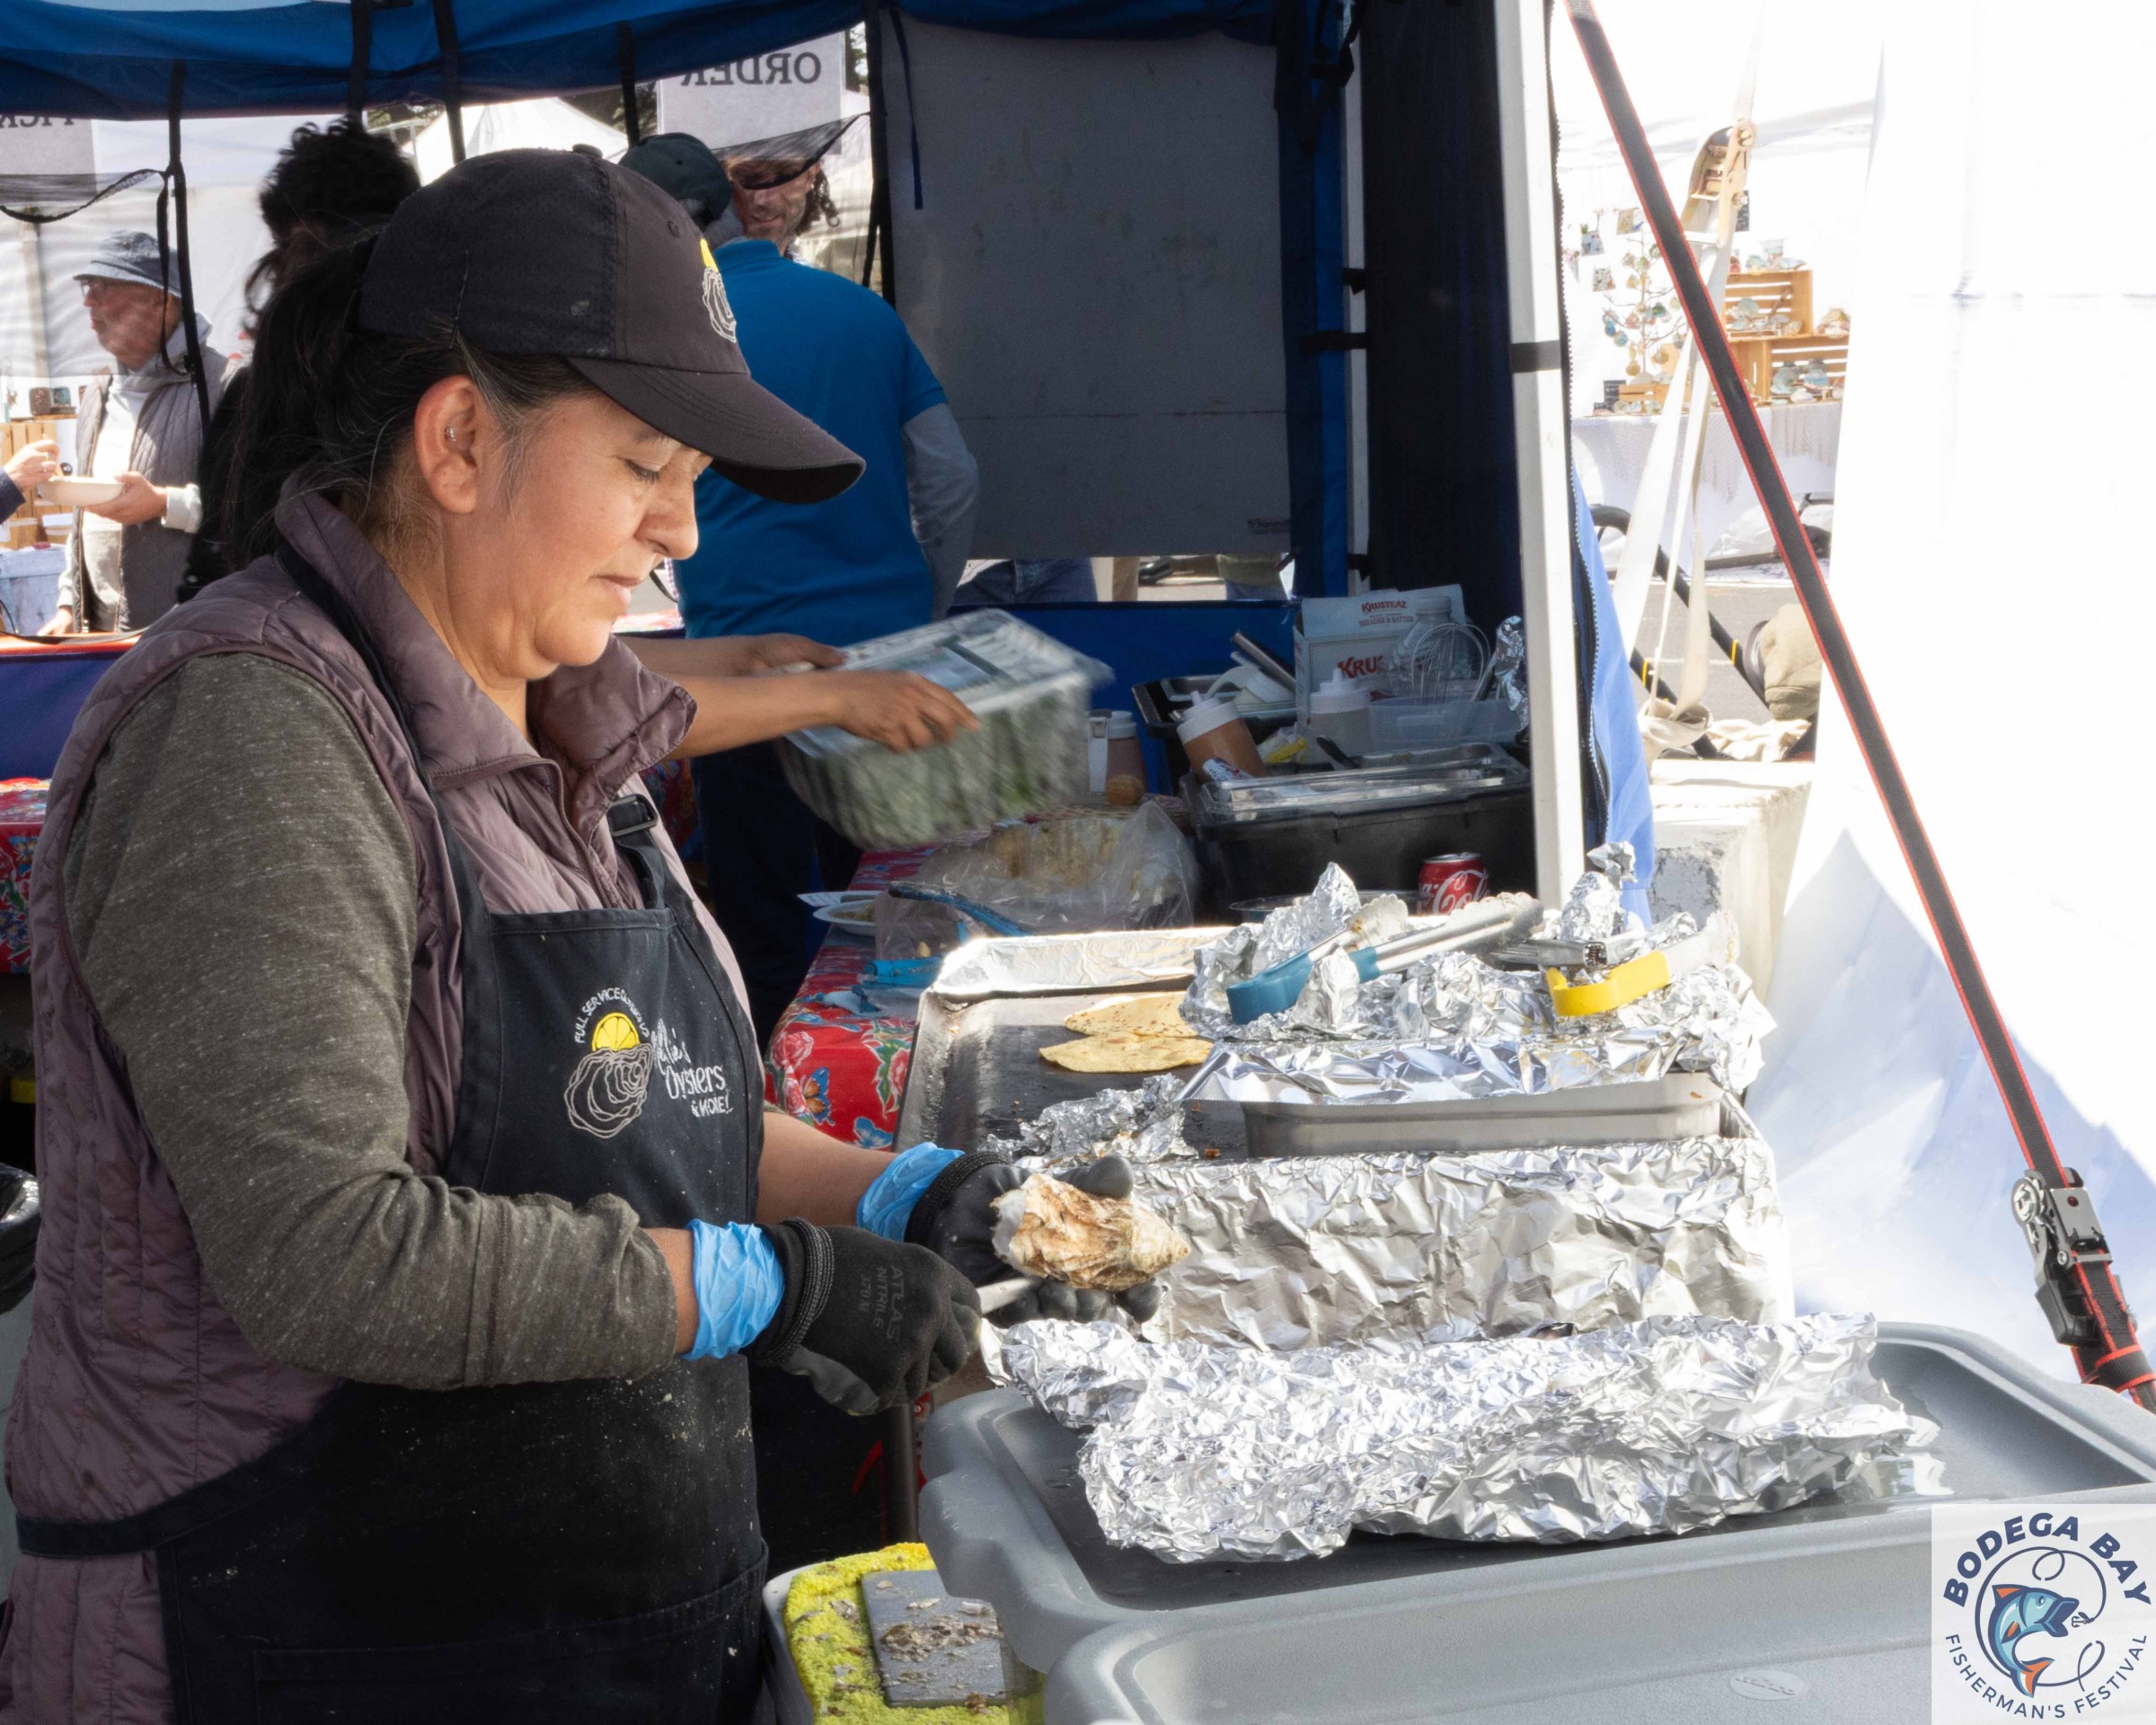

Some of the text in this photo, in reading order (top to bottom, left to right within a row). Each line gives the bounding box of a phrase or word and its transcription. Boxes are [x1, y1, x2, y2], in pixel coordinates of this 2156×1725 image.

[574, 986, 621, 1044] FULL SERVICE
[872, 1265, 888, 1330] NITRILE
[886, 1264, 906, 1340] ATLAS
